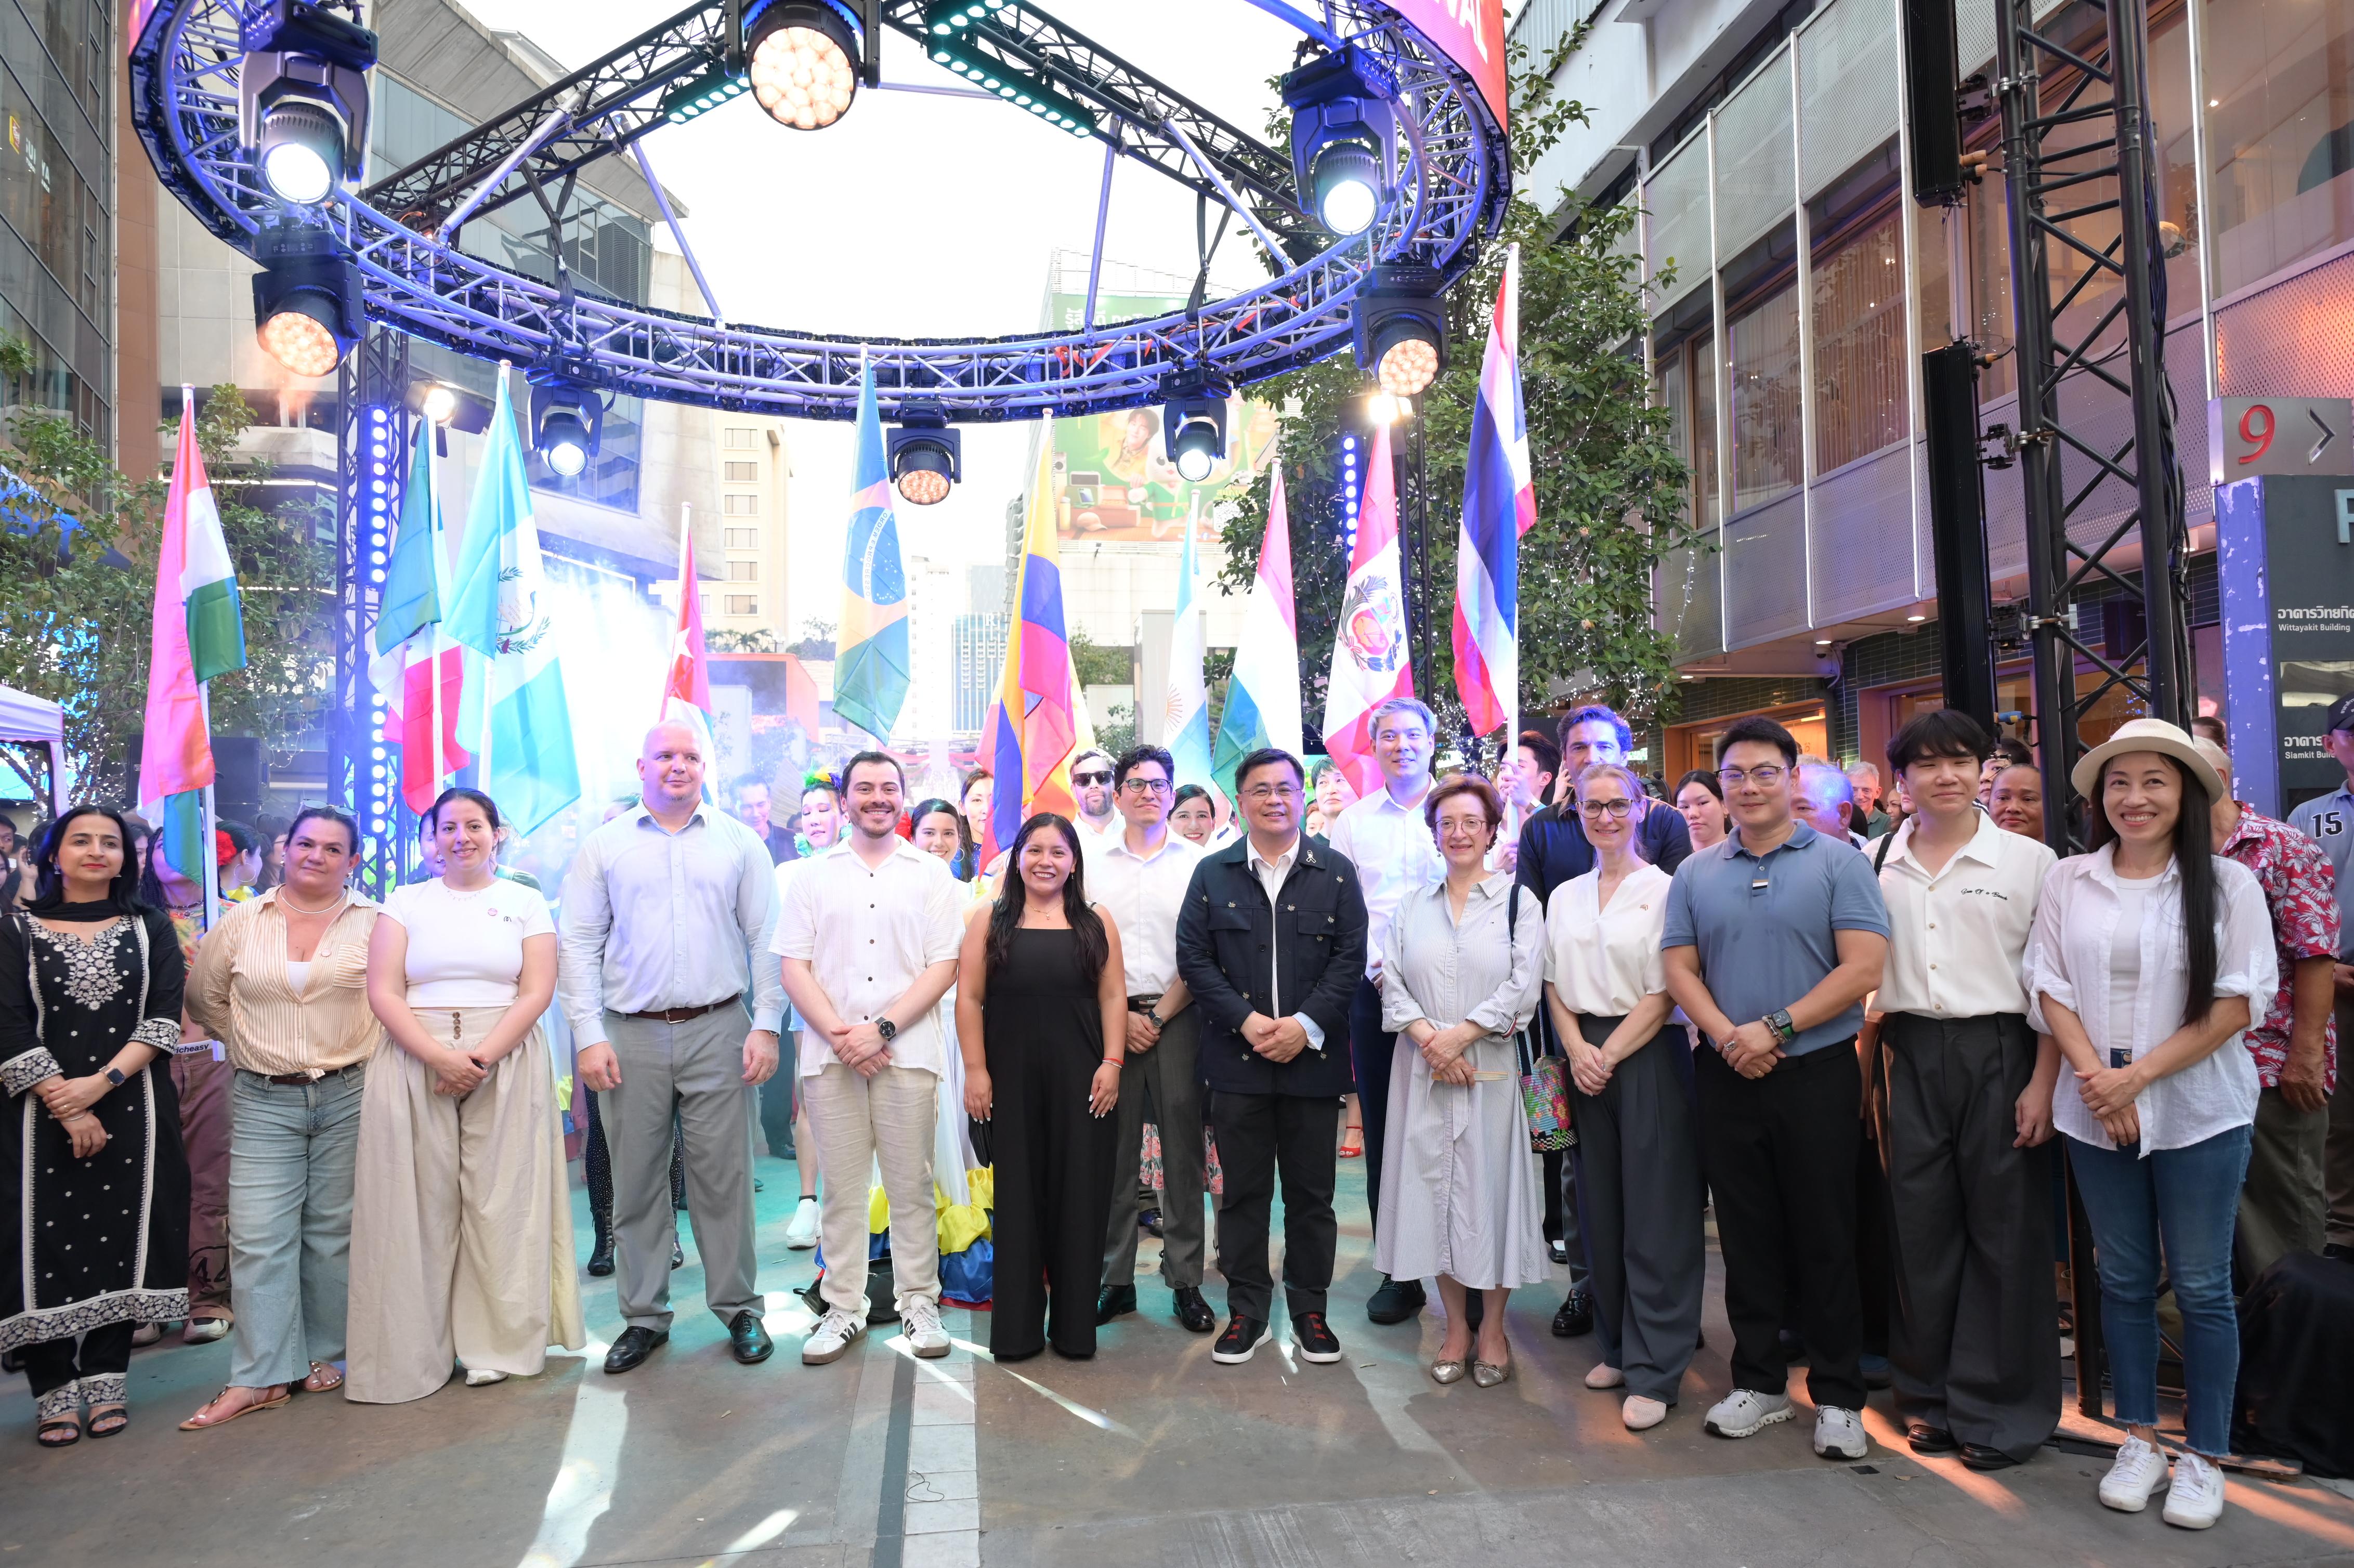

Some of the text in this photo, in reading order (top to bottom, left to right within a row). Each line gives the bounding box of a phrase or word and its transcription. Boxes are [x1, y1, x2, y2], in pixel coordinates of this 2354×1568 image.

[2239, 404, 2276, 464] 9
[2279, 624, 2351, 633] Wittayakit Building
[2311, 811, 2344, 839] 15
